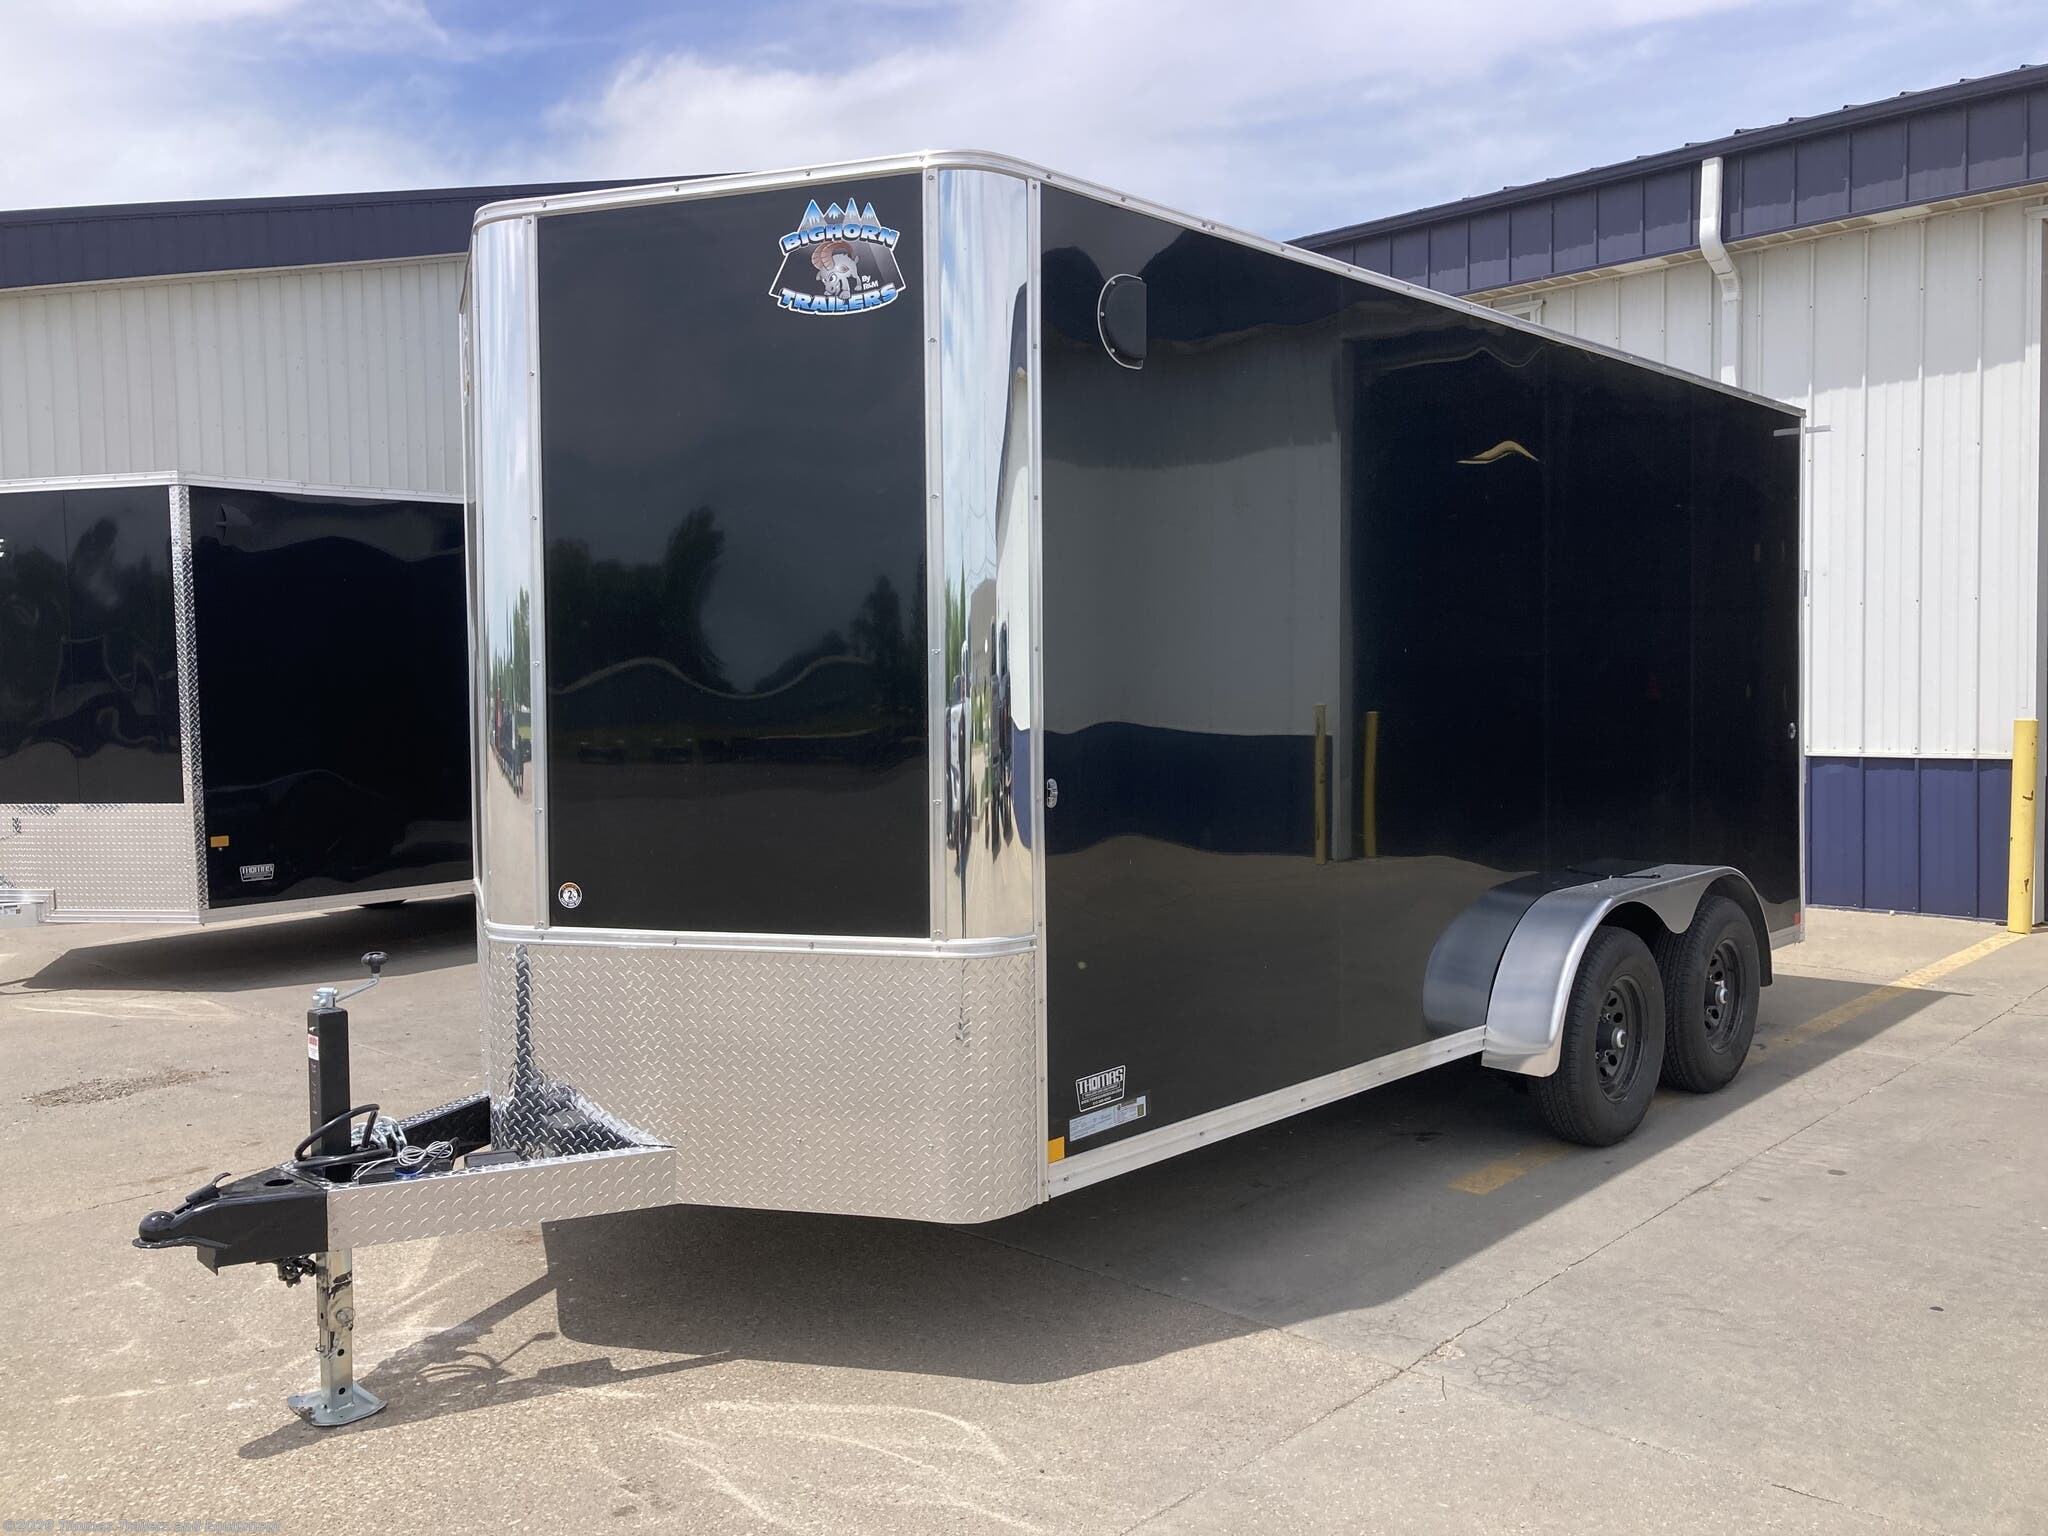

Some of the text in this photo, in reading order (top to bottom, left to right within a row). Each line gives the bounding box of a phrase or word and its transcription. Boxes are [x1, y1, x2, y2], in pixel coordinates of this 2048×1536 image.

[782, 223, 899, 252] BIGHORN
[781, 283, 897, 311] TRAILERS
[1078, 1068, 1123, 1095] THOMAS
